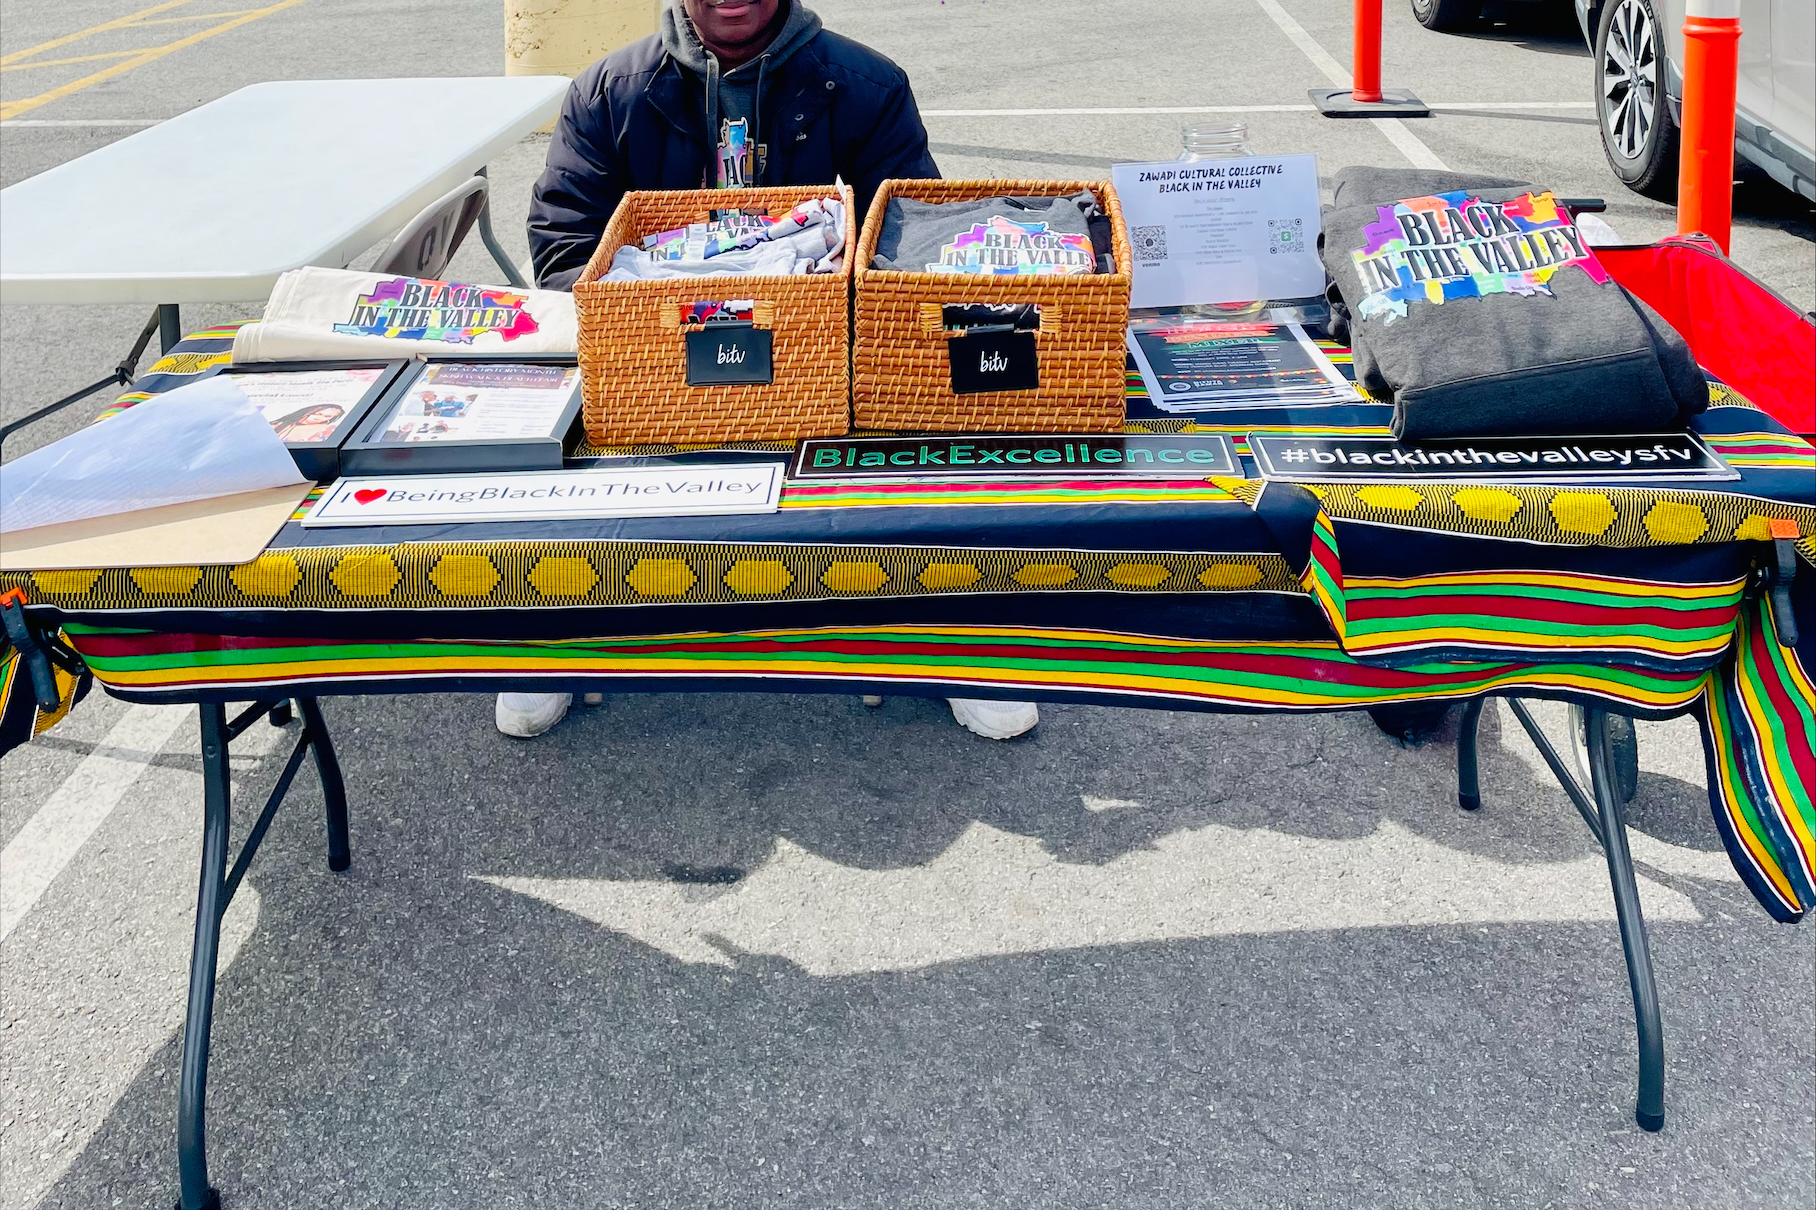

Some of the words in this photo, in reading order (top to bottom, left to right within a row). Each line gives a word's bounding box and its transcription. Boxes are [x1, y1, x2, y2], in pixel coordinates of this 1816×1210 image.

[1139, 169, 1176, 182] ZAWADI
[1179, 168, 1225, 180] CULTURAL
[1228, 164, 1283, 177] COLLECTIVE
[1159, 181, 1190, 193] BLACK
[1192, 181, 1202, 191] IN
[1206, 179, 1225, 191] THE
[1228, 178, 1262, 189] VALLEY
[1396, 205, 1521, 247] BLACK
[985, 233, 1065, 250] BLACK
[946, 250, 968, 266] IN
[976, 248, 1018, 266] THE
[1026, 249, 1090, 266] VALLE
[1359, 254, 1400, 294] IN
[1400, 246, 1469, 281] THE
[1468, 227, 1588, 275] VALLEY
[399, 283, 485, 308] BLACK
[351, 306, 381, 328] IN
[386, 307, 433, 328] THE
[438, 308, 520, 328] VALLEY
[717, 344, 746, 365] bitv
[980, 351, 1008, 373] bitv
[813, 443, 1216, 468] BlackExcellence
[1281, 444, 1692, 467] #blackinthevalleysfv
[339, 491, 350, 504] I
[387, 480, 763, 506] BeingBlackInTheValley
